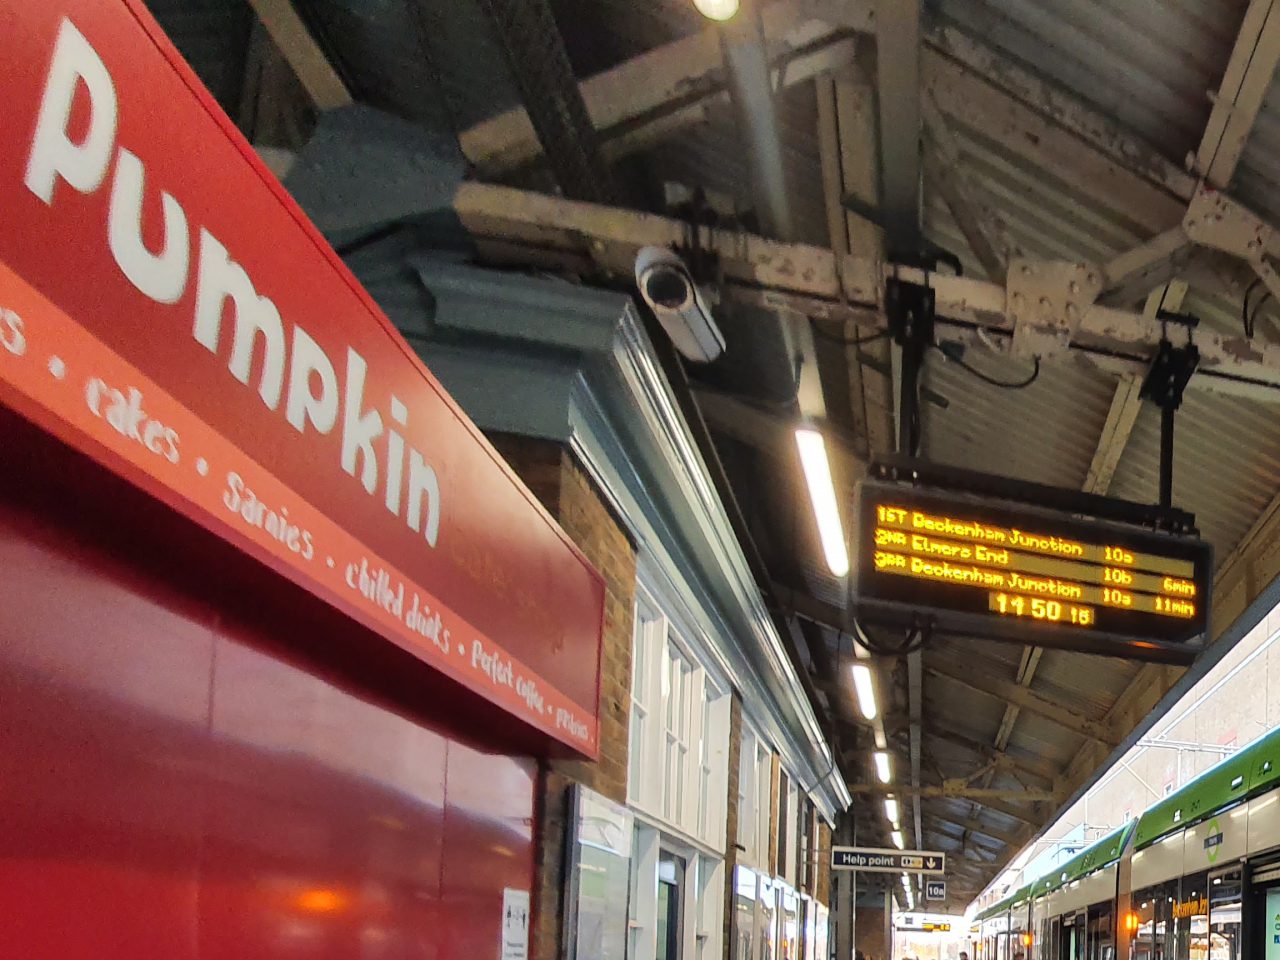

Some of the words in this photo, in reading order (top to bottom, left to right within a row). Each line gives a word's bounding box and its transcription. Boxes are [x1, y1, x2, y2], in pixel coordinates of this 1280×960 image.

[25, 16, 440, 548] Pumpkin
[911, 534, 972, 559] Elmers
[975, 543, 1009, 564] End
[1104, 567, 1132, 585] 10b
[912, 511, 1006, 542] Beckenham
[1009, 529, 1083, 556] Junction
[1104, 545, 1133, 564] 10a
[911, 555, 1004, 587] Beckenham
[1007, 572, 1081, 599] Junction
[1103, 587, 1132, 606] 10a
[842, 853, 867, 867] Help
[868, 855, 895, 867] point
